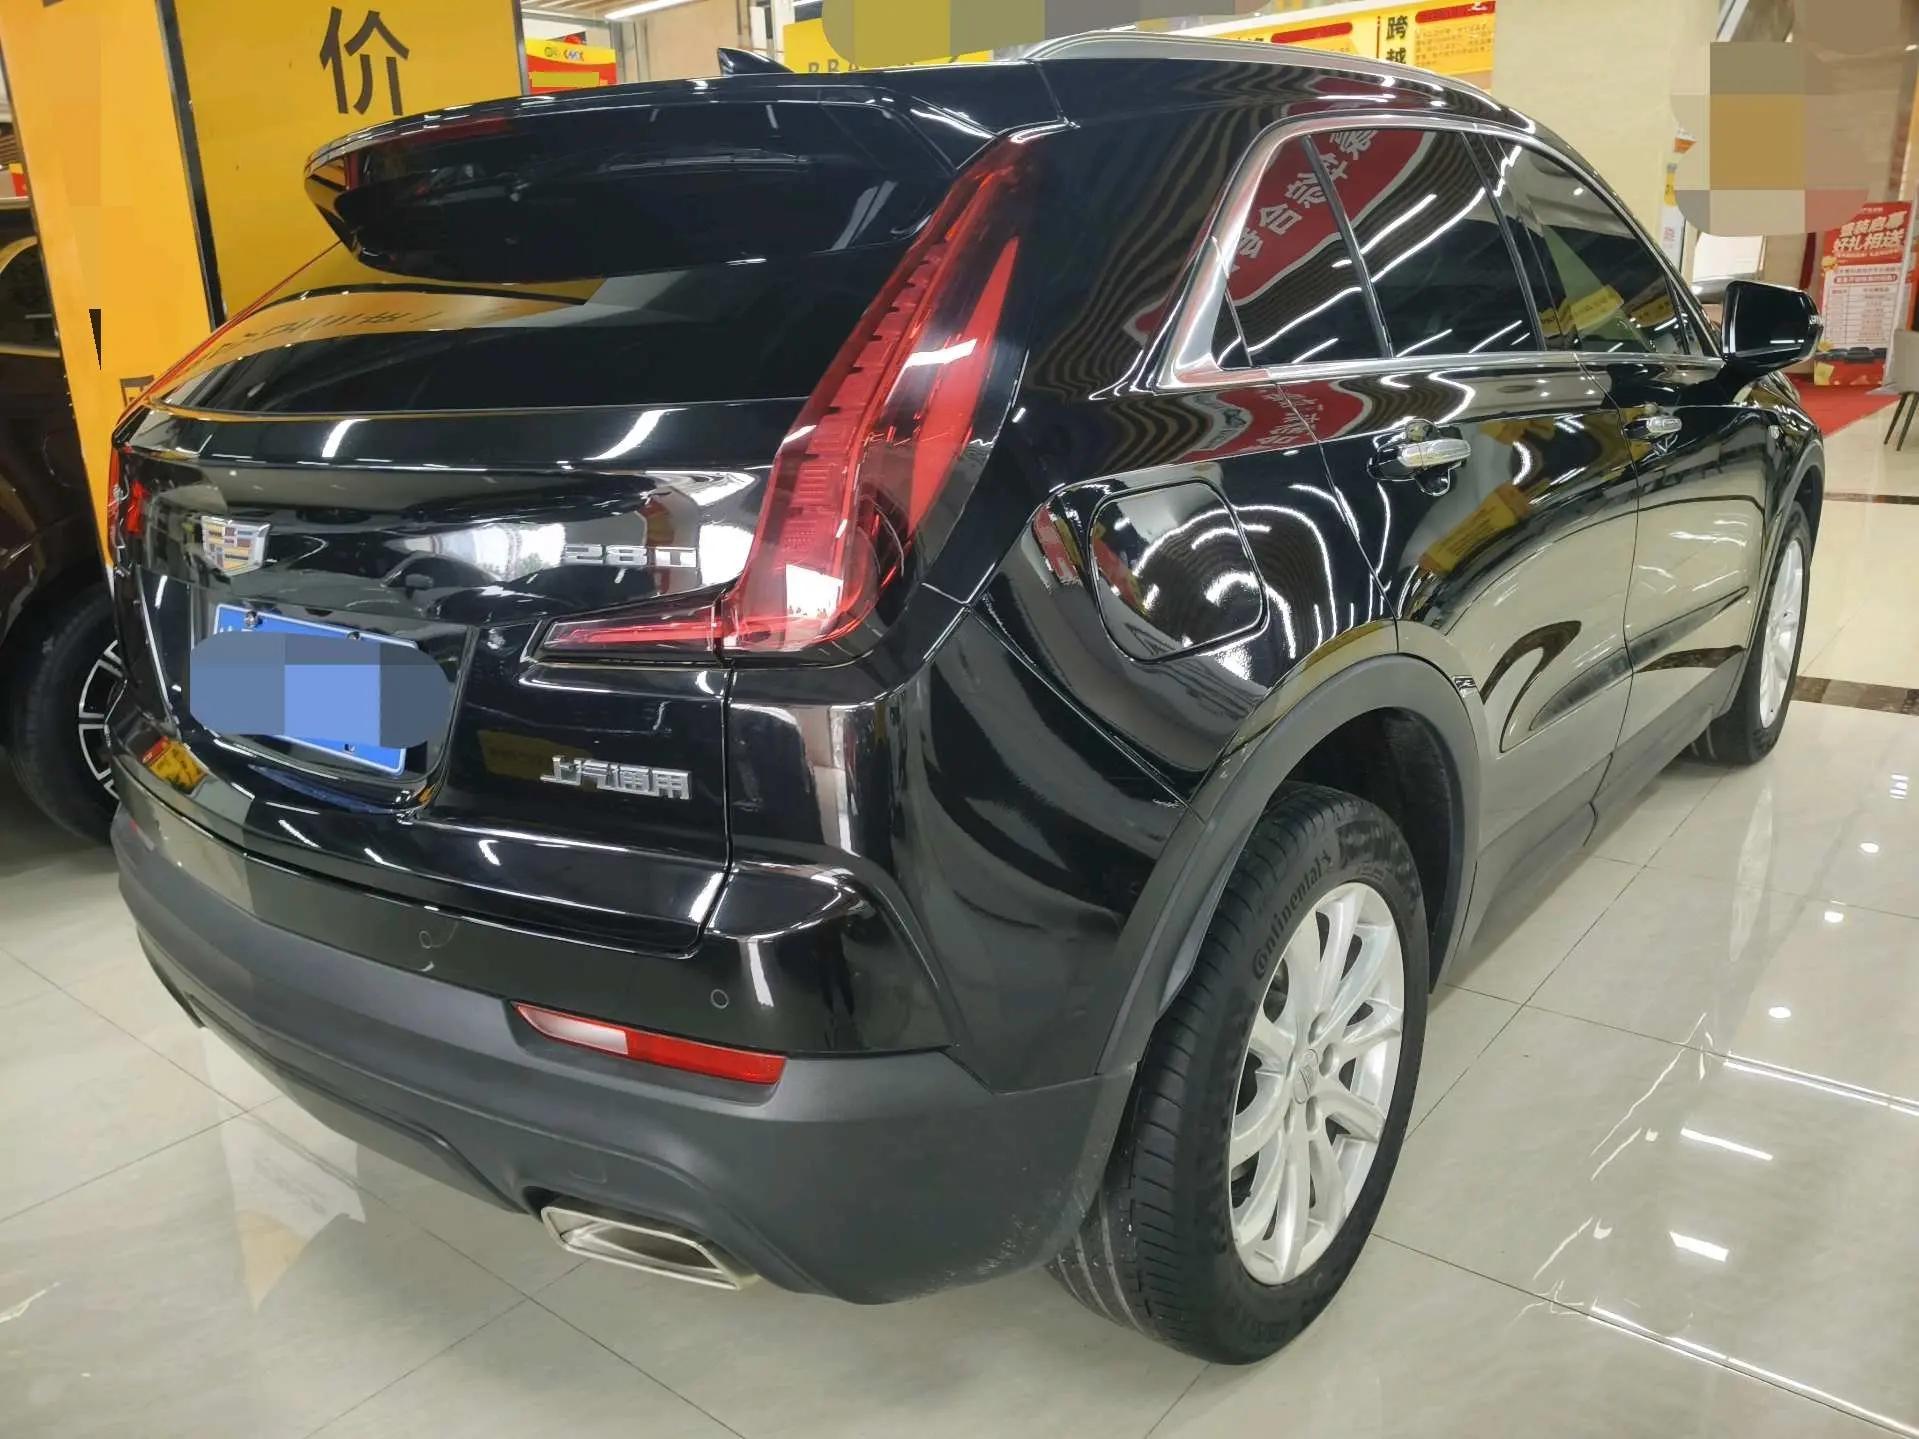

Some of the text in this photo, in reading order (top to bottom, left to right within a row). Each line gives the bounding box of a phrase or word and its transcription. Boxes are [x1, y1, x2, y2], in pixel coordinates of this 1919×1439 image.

[319, 6, 410, 116] 价
[1386, 16, 1408, 64] 跨越
[1832, 228, 1905, 253] 好礼相送
[563, 544, 697, 568] 28T
[540, 756, 691, 800] 上汽通用
[1252, 856, 1325, 981] Continental
